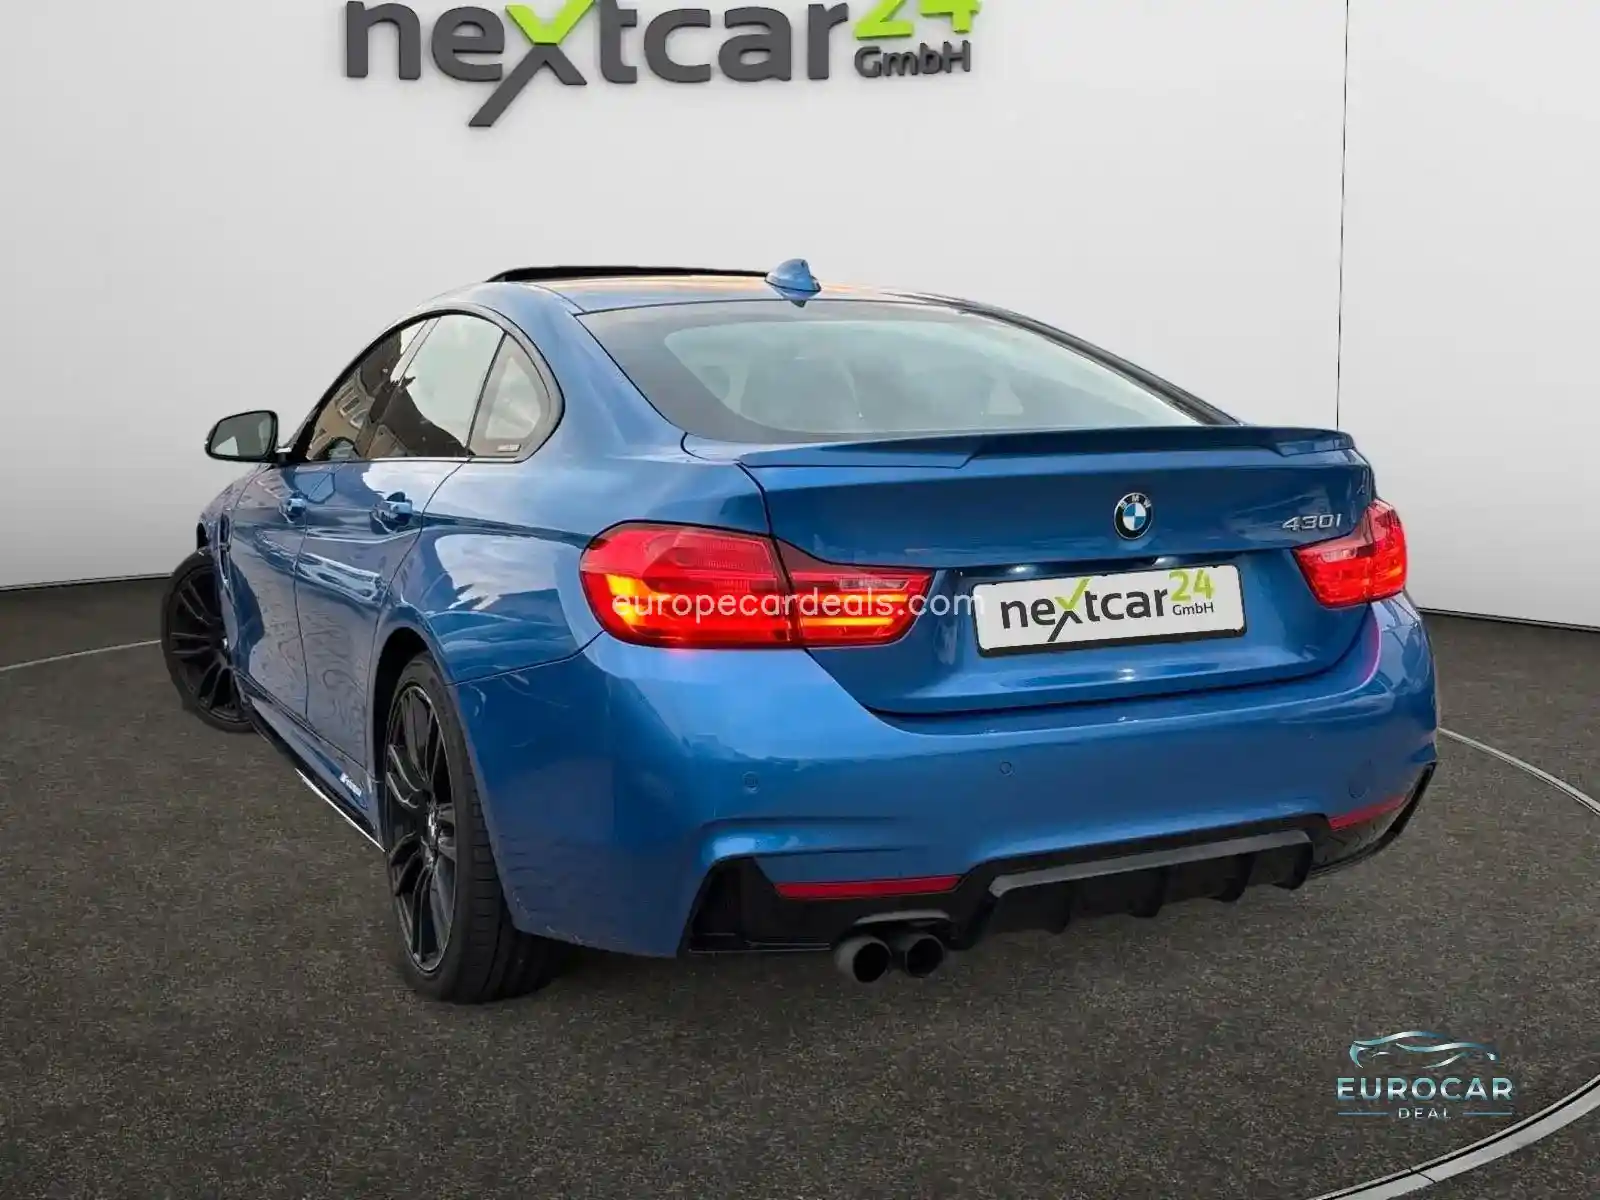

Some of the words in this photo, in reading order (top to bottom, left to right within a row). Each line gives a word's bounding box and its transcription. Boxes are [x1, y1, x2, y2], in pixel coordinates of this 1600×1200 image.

[854, 40, 972, 78] GmbH
[1000, 569, 1215, 643] nextcar24
[1172, 602, 1215, 616] GmbH
